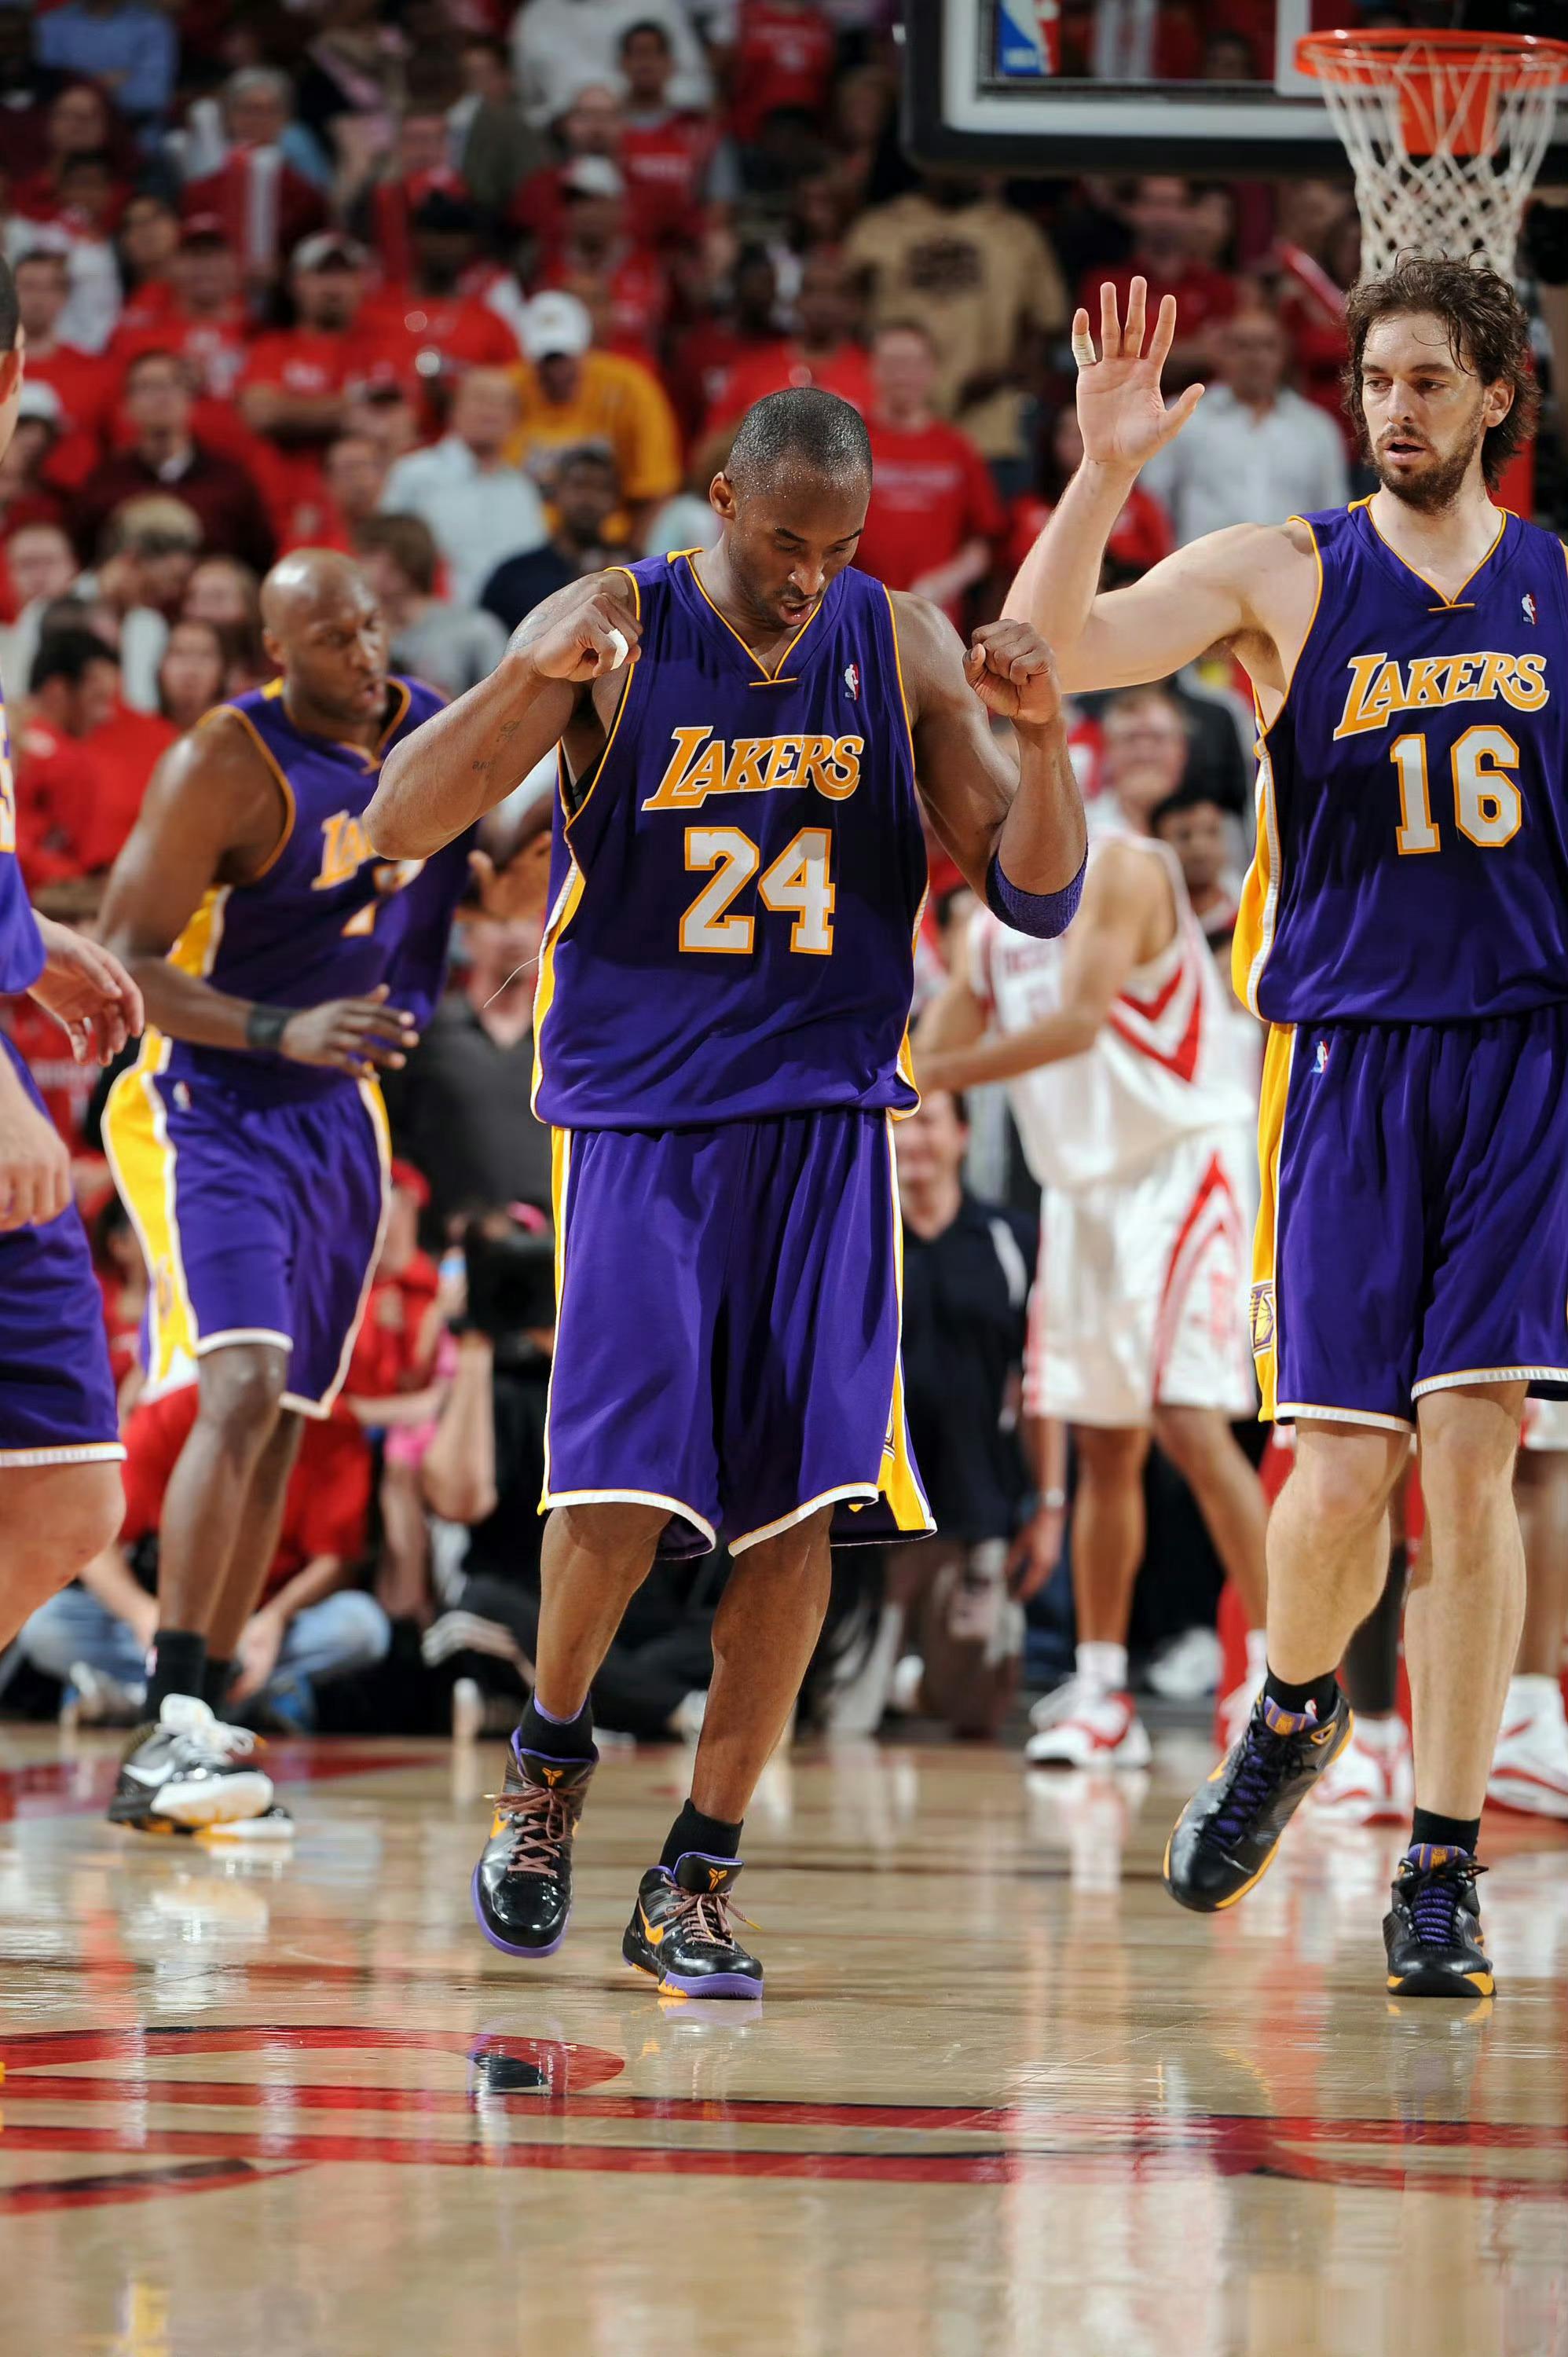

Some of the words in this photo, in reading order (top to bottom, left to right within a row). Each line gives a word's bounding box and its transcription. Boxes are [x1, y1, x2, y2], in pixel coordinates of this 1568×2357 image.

[1333, 651, 1550, 741] LAKERS
[641, 726, 864, 811] LAKERS
[1390, 725, 1522, 855] 16
[679, 827, 835, 955] 24
